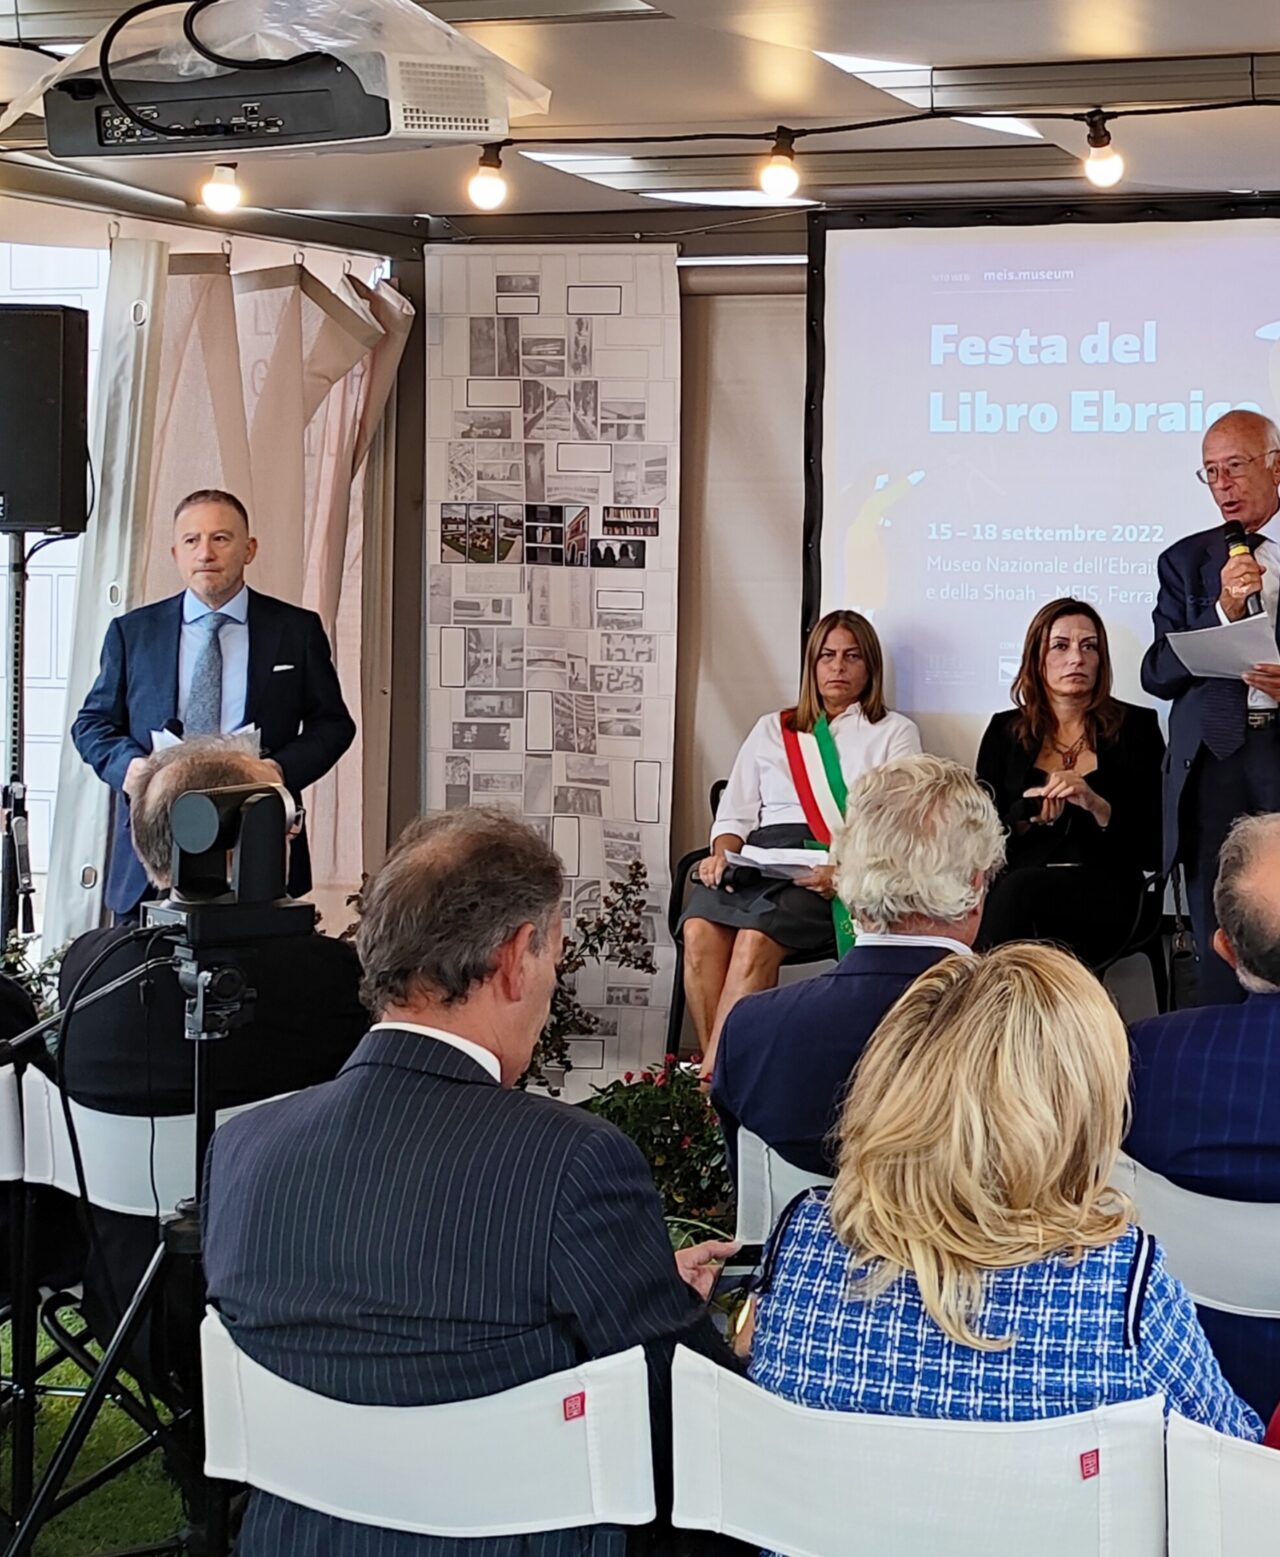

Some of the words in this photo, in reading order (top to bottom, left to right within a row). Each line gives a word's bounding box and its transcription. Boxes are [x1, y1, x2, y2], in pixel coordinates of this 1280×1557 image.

[984, 269, 1073, 281] meis.museum
[930, 323, 1067, 366] Festa
[1079, 320, 1157, 364] del
[929, 391, 1058, 433] Libro
[1070, 390, 1262, 433] Ebraic
[928, 523, 951, 540] 15
[972, 524, 996, 541] 18
[1002, 524, 1106, 542] settembre
[1112, 525, 1164, 543] 2022
[927, 556, 980, 574] Museo
[987, 556, 1068, 574] Nazionale
[926, 588, 936, 600] e
[940, 584, 978, 601] della
[983, 584, 1035, 602] Shoah
